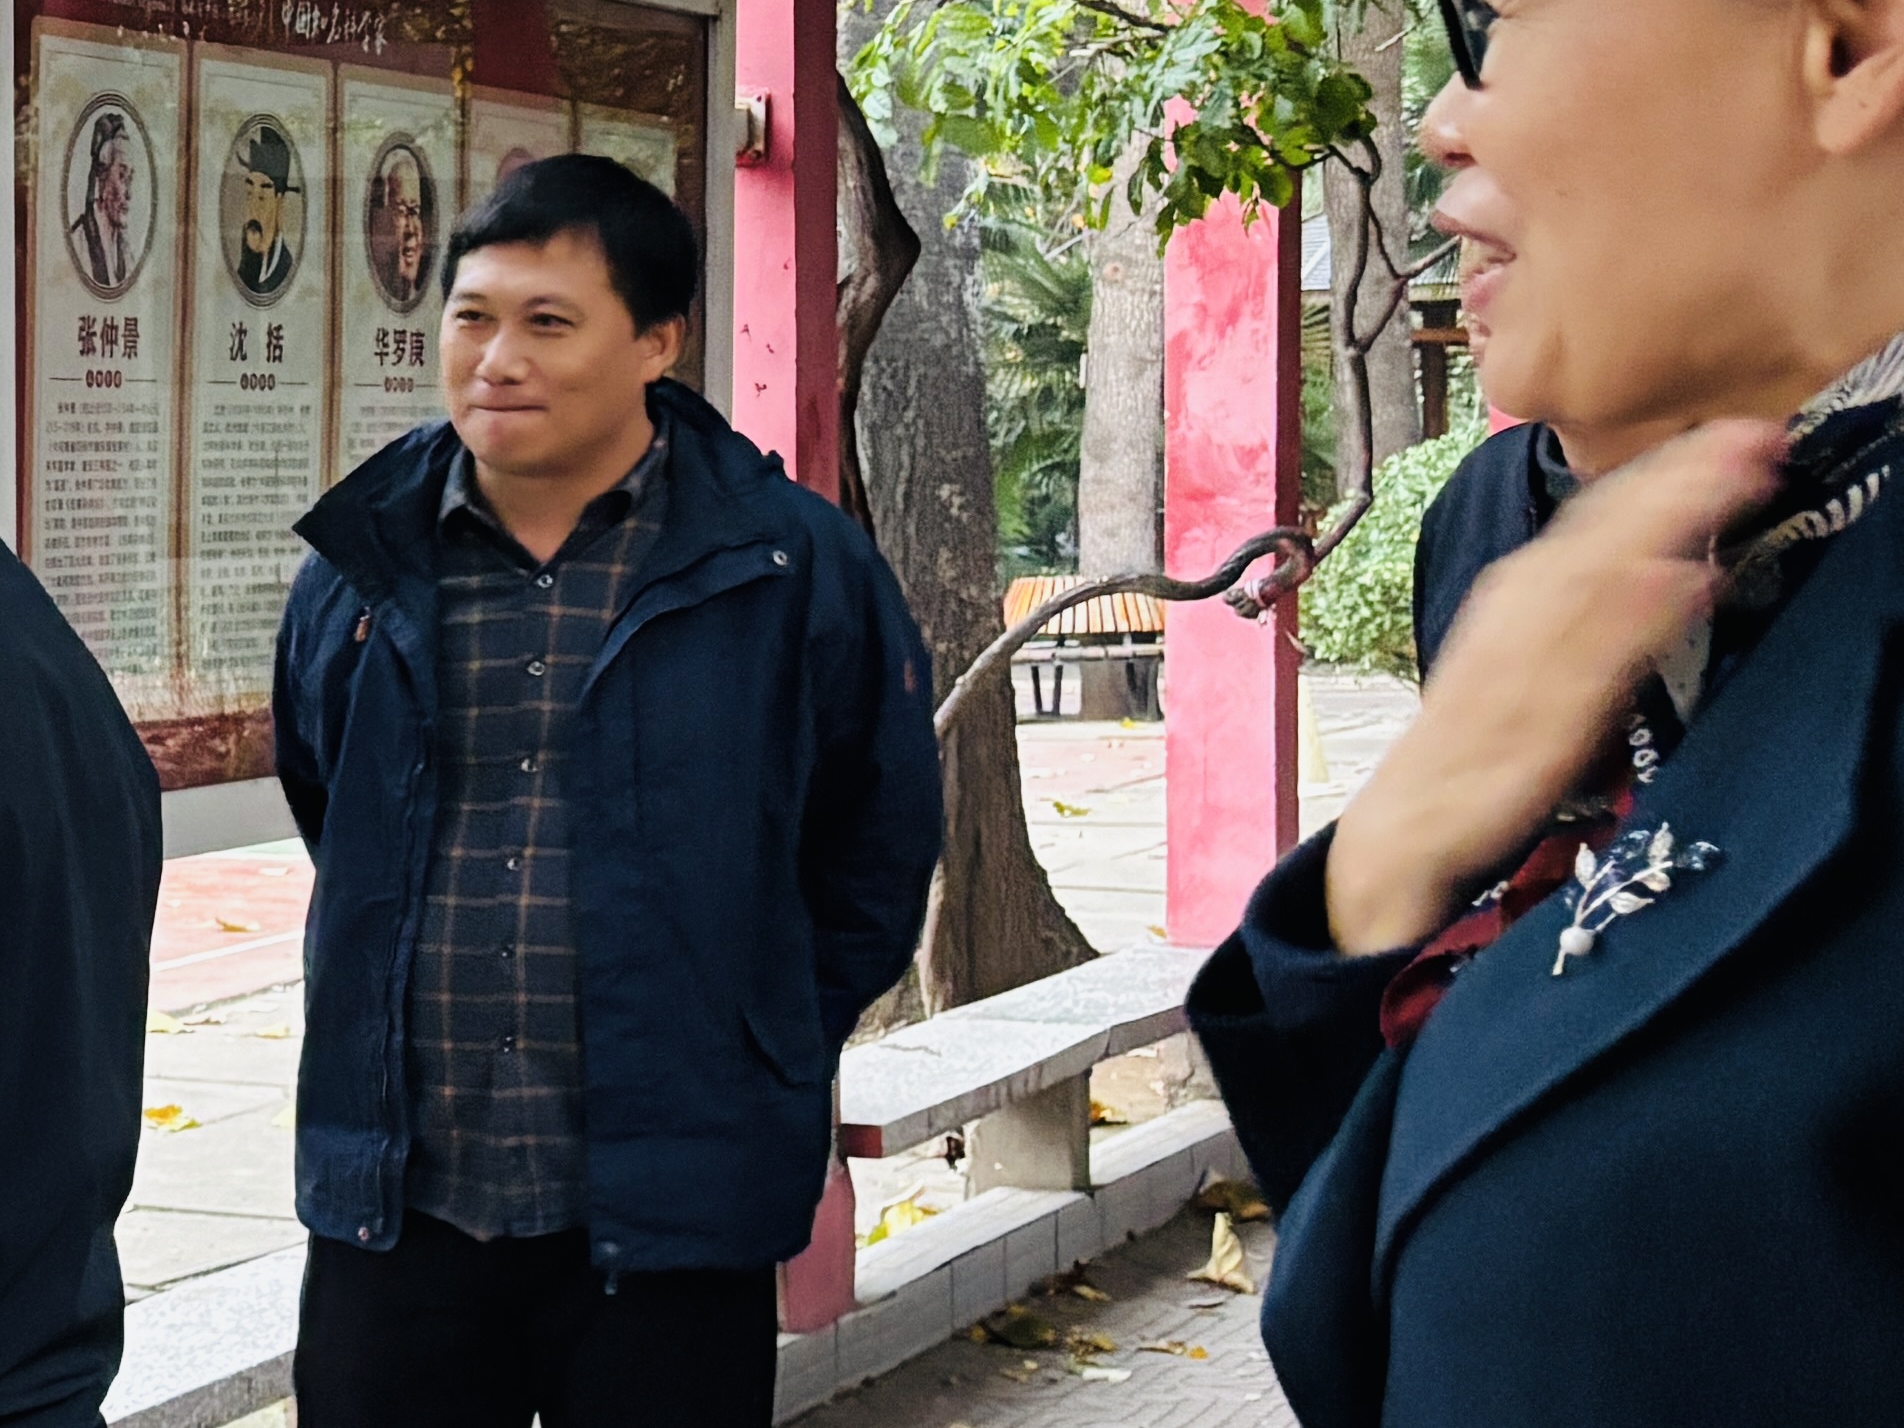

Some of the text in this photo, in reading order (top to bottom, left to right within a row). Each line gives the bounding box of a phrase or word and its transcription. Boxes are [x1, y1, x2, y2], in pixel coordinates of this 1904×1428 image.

[77, 315, 141, 360] 张仲景
[374, 327, 426, 368] 华罗庚
